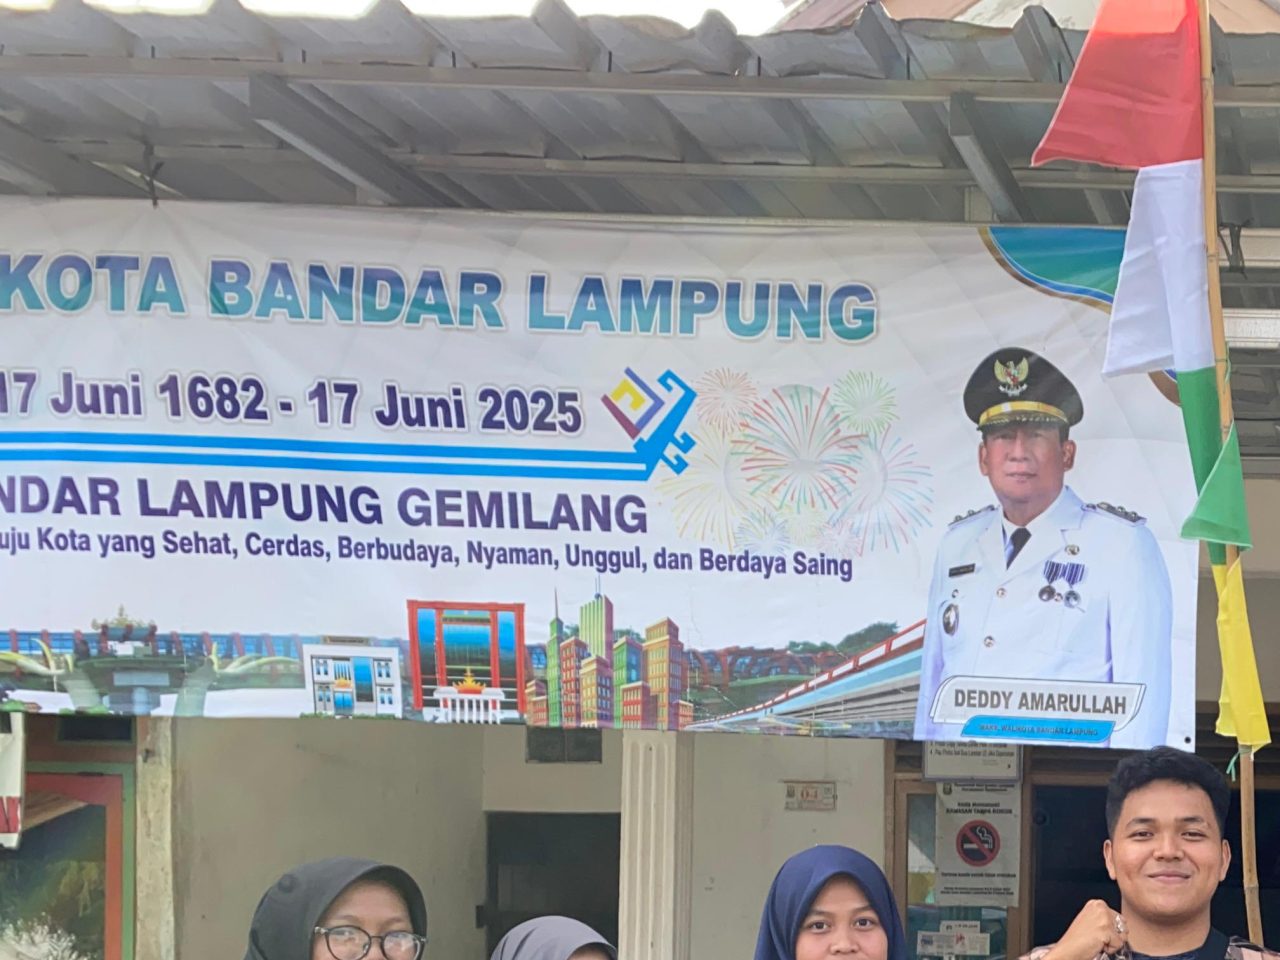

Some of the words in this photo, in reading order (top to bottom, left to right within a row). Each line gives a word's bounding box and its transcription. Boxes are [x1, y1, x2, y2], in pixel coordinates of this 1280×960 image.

[0, 253, 186, 313] KOTA
[208, 259, 505, 328] BANDAR
[528, 274, 877, 339] LAMPUNG
[51, 371, 143, 417] Juni
[159, 374, 269, 421] 1682
[307, 381, 359, 425] 17
[375, 384, 467, 429] Juni
[478, 388, 582, 433] 2025
[137, 478, 384, 525] LAMPUNG
[397, 487, 648, 533] GEMILANG
[37, 527, 91, 551] Kota
[97, 531, 155, 559] yang
[162, 530, 238, 559] Sehat,
[245, 532, 332, 562] Cerdas,
[337, 536, 460, 568] Berbudaya,
[467, 540, 559, 570] Nyaman,
[565, 544, 647, 574] Unggul,
[653, 547, 692, 570] dan
[699, 548, 787, 579] Berdaya
[792, 552, 853, 582] Saing
[954, 689, 1014, 710] DEDDY
[1018, 692, 1127, 714] AMARULLAH
